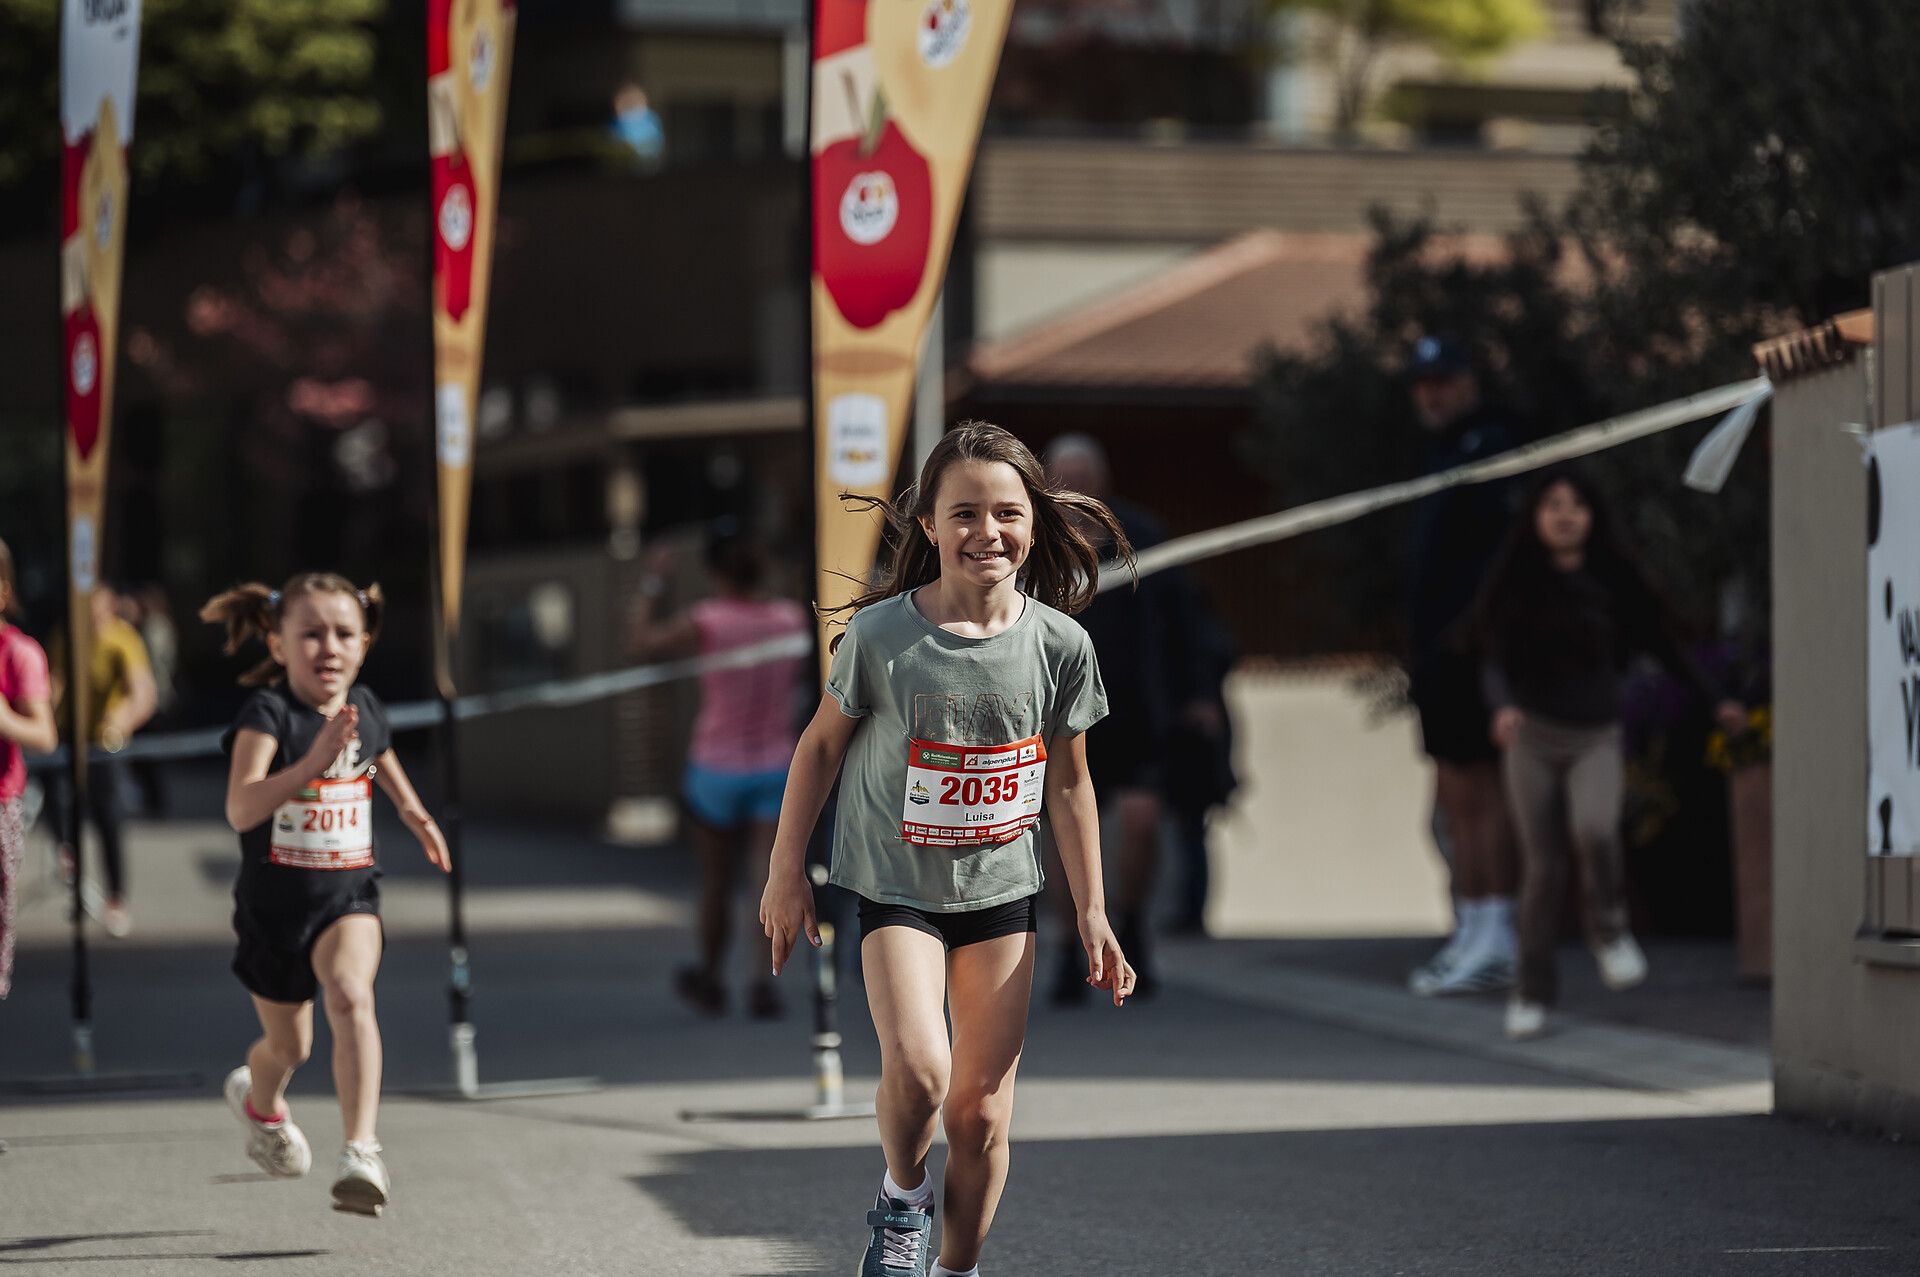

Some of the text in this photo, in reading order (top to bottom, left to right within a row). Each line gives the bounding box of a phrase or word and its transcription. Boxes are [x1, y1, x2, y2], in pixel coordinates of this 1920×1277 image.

[982, 756, 1016, 766] alpenplus
[939, 773, 1019, 806] 2035
[303, 808, 357, 832] 2014
[965, 812, 995, 822] Luisa
